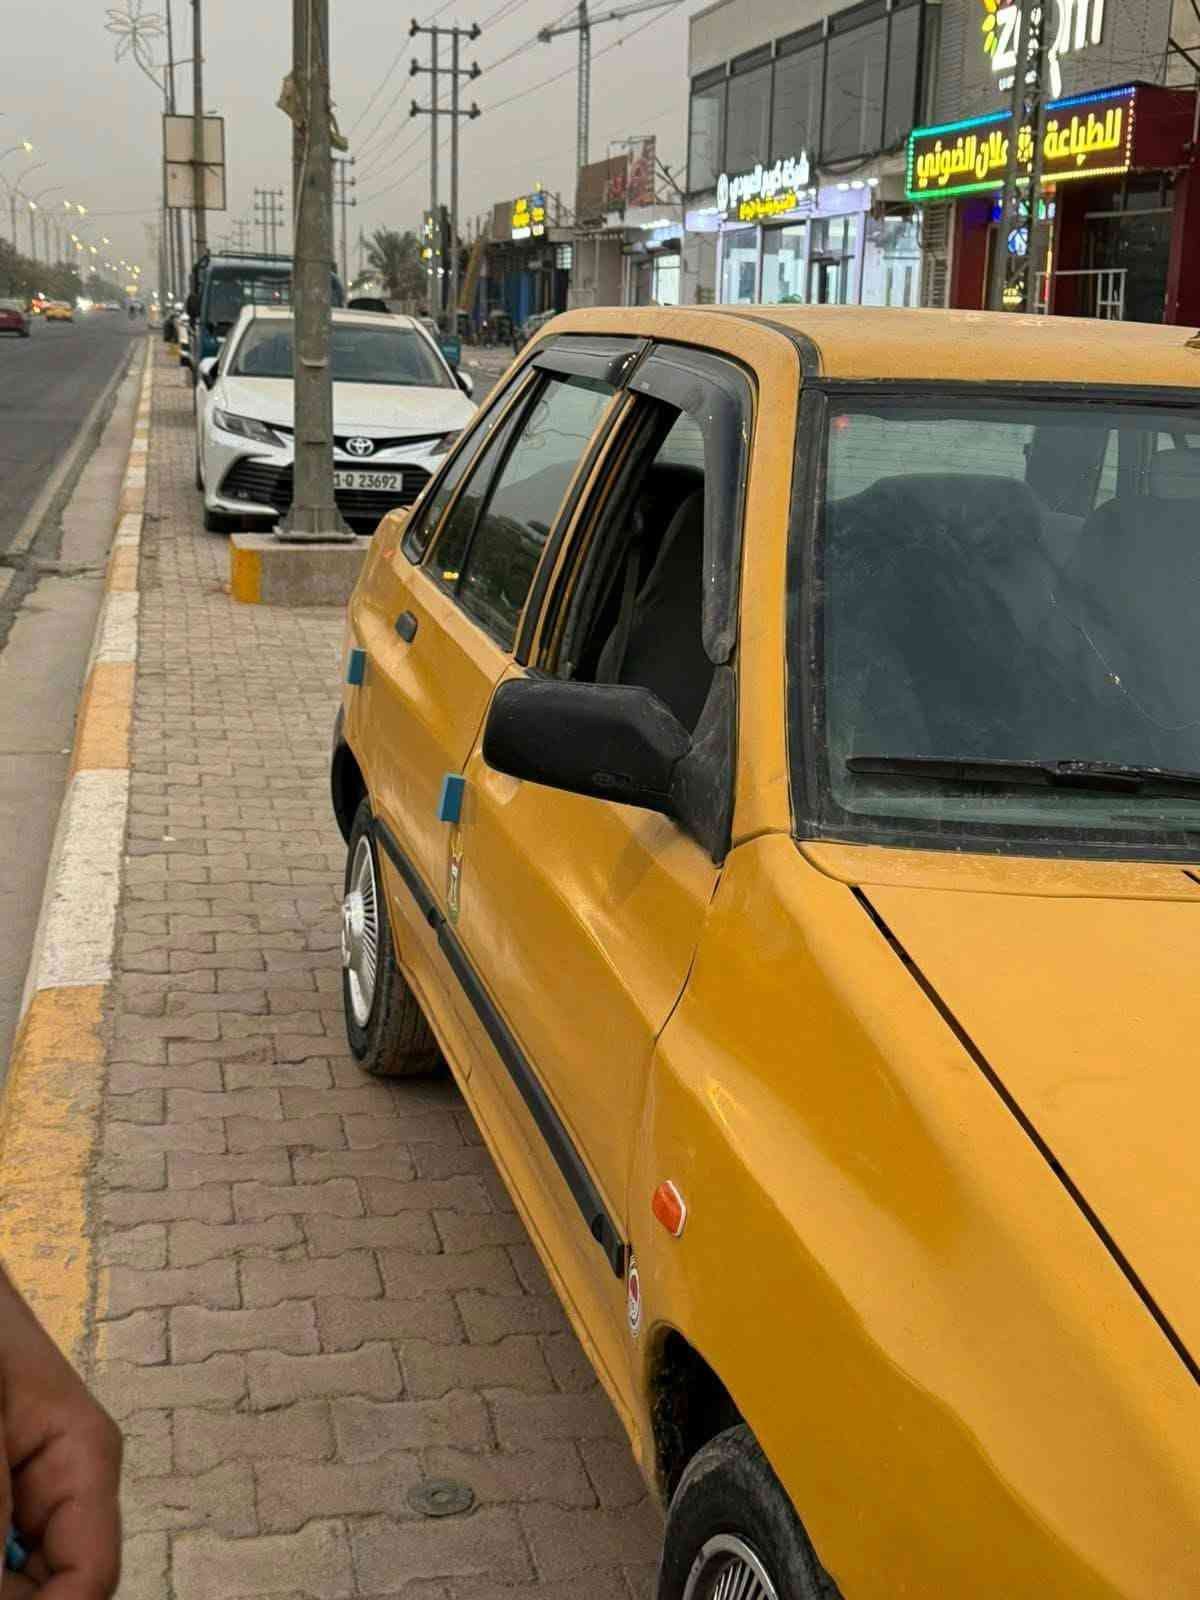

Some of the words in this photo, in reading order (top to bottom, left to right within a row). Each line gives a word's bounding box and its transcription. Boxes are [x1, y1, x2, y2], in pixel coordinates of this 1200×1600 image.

[917, 133, 977, 189] الضوئي
[1043, 107, 1123, 166] للطباعة
[359, 473, 398, 490] 23692
